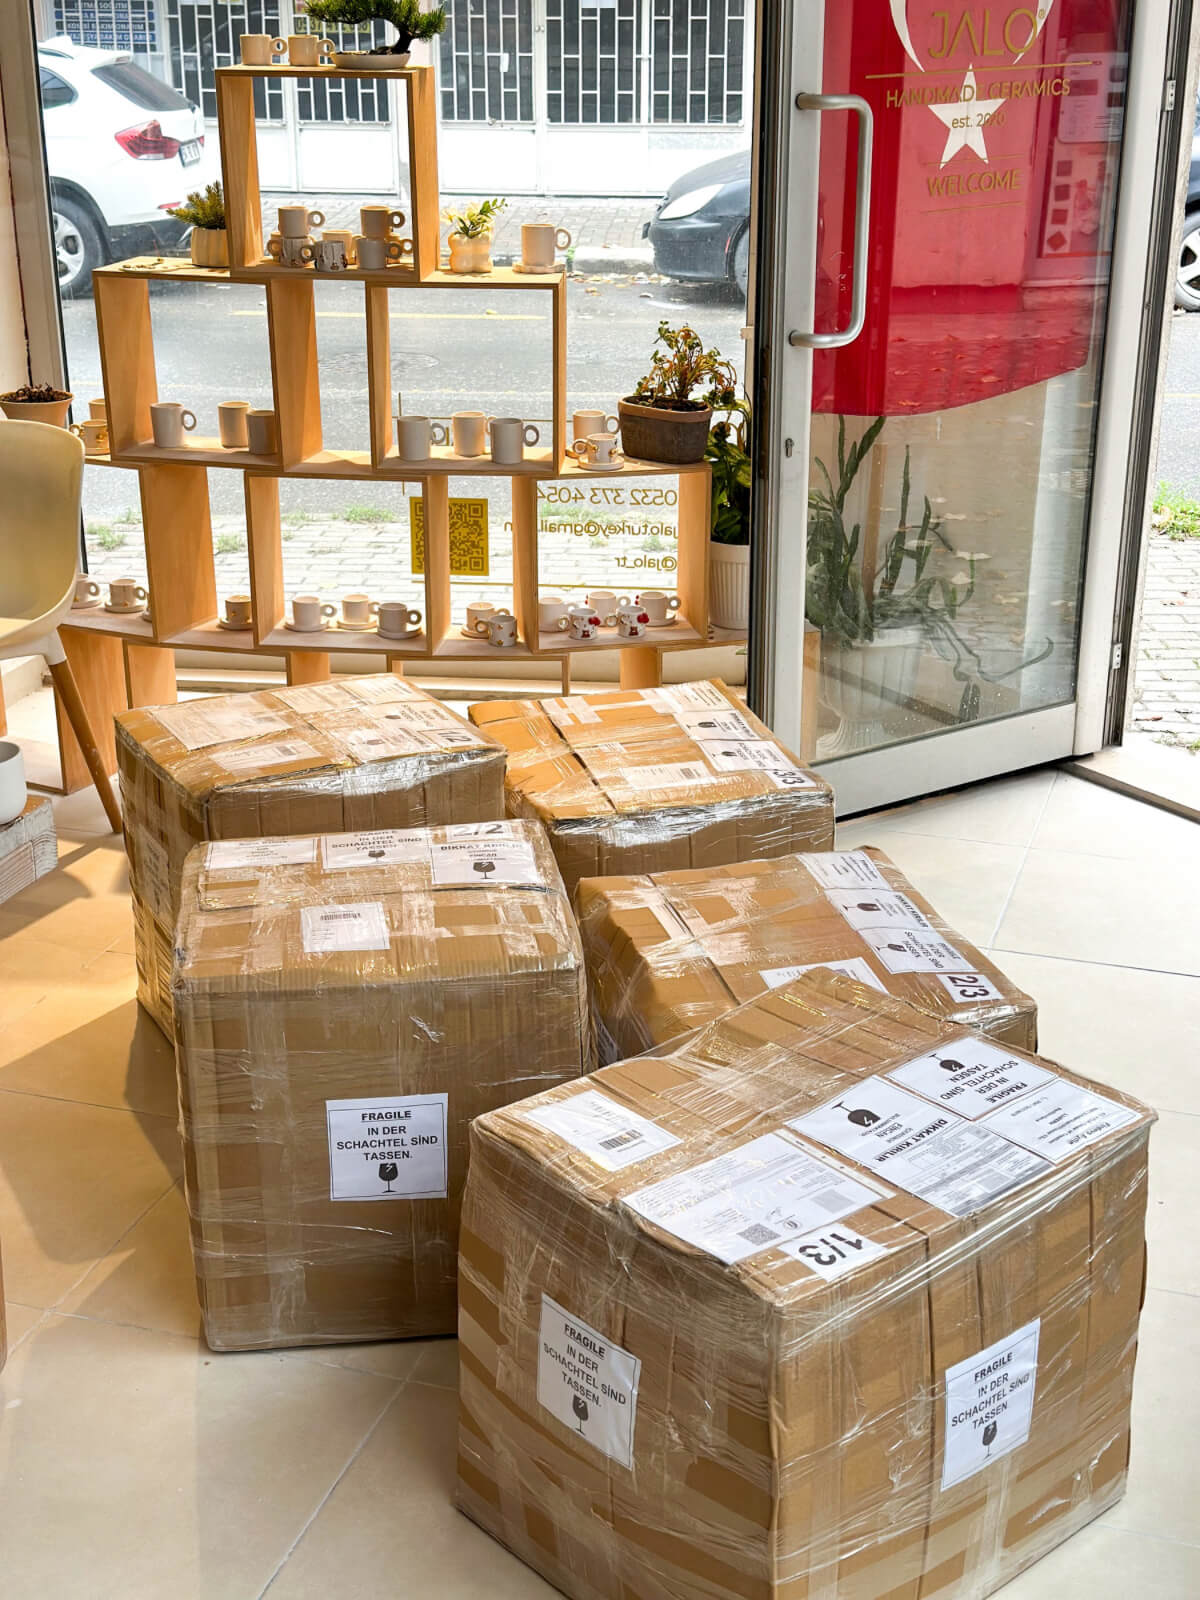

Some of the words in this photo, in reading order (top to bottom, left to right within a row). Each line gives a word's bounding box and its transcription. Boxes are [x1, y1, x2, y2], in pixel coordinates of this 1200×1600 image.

[928, 8, 1038, 58] JALO
[886, 84, 985, 108] HANDMADE
[989, 79, 1071, 101] CERAMICS
[951, 115, 973, 129] est.
[927, 169, 1023, 197] WELCOME
[947, 976, 990, 998] 2/3
[961, 1059, 1019, 1090] SCHACHTEL
[976, 1082, 999, 1094] DER
[987, 1082, 1028, 1104] FRAGILE
[361, 1110, 412, 1122] FRAGILE
[336, 1138, 408, 1150] SCHACHTEL
[367, 1127, 379, 1136] IN
[382, 1125, 407, 1135] DER
[876, 1139, 911, 1162] KIRILIR
[798, 1232, 863, 1266] 1/3
[564, 1323, 606, 1359] FRAGILE
[543, 1342, 599, 1389] SCHACHTEL
[566, 1344, 576, 1359] IN
[578, 1352, 599, 1374] DER
[974, 1352, 1013, 1382] FRAGILE
[978, 1385, 988, 1398] IN
[989, 1372, 1009, 1391] DER
[951, 1389, 1007, 1427] SCHACHTEL
